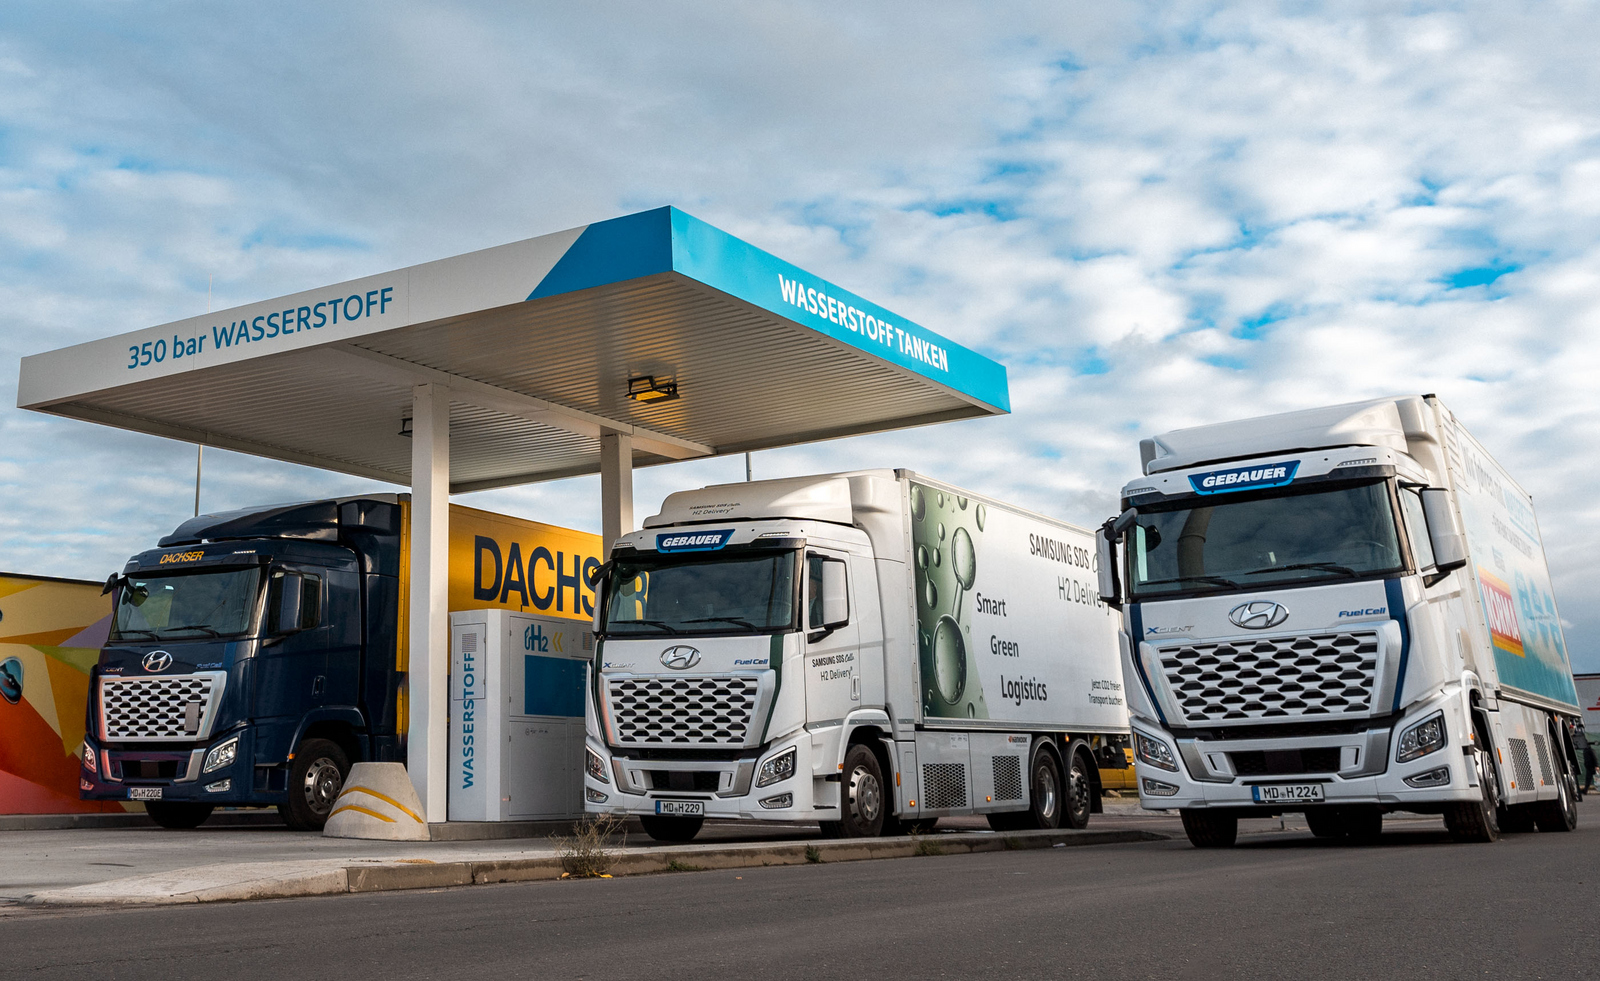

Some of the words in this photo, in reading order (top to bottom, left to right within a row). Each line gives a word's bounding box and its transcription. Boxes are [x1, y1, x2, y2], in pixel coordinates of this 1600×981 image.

[127, 342, 167, 370] 350
[172, 333, 207, 360] bar
[212, 286, 393, 350] WASSERSTOFF
[778, 273, 894, 348] WASSERSTOFF
[895, 328, 949, 373] TANKEN
[1202, 466, 1287, 488] GEBAUER
[662, 533, 723, 548] GEBAUER
[159, 550, 205, 565] DACHSER
[1029, 533, 1073, 566] SAMSUNG
[1074, 546, 1090, 570] SDS
[1057, 575, 1072, 602] H2
[976, 591, 1007, 618] Smart
[1338, 608, 1364, 618] Fuel
[1364, 606, 1386, 617] Cell
[1481, 583, 1522, 642] NORMA
[1145, 625, 1195, 635] XCIENT
[990, 635, 1020, 658] Green
[811, 656, 836, 668] SAMSUNG
[836, 654, 845, 664] SDS
[820, 670, 829, 682] H2
[1091, 679, 1101, 691] Jetzt
[1101, 680, 1110, 690] CO2
[1001, 675, 1048, 707] Logistics
[1088, 693, 1108, 707] Transport
[1108, 694, 1123, 706] buchen
[463, 652, 476, 790] WASSERSTOFF
[1263, 787, 1279, 799] MD
[1286, 787, 1295, 798] H
[1296, 786, 1319, 798] 224
[663, 803, 674, 812] MD
[685, 804, 700, 813] 229
